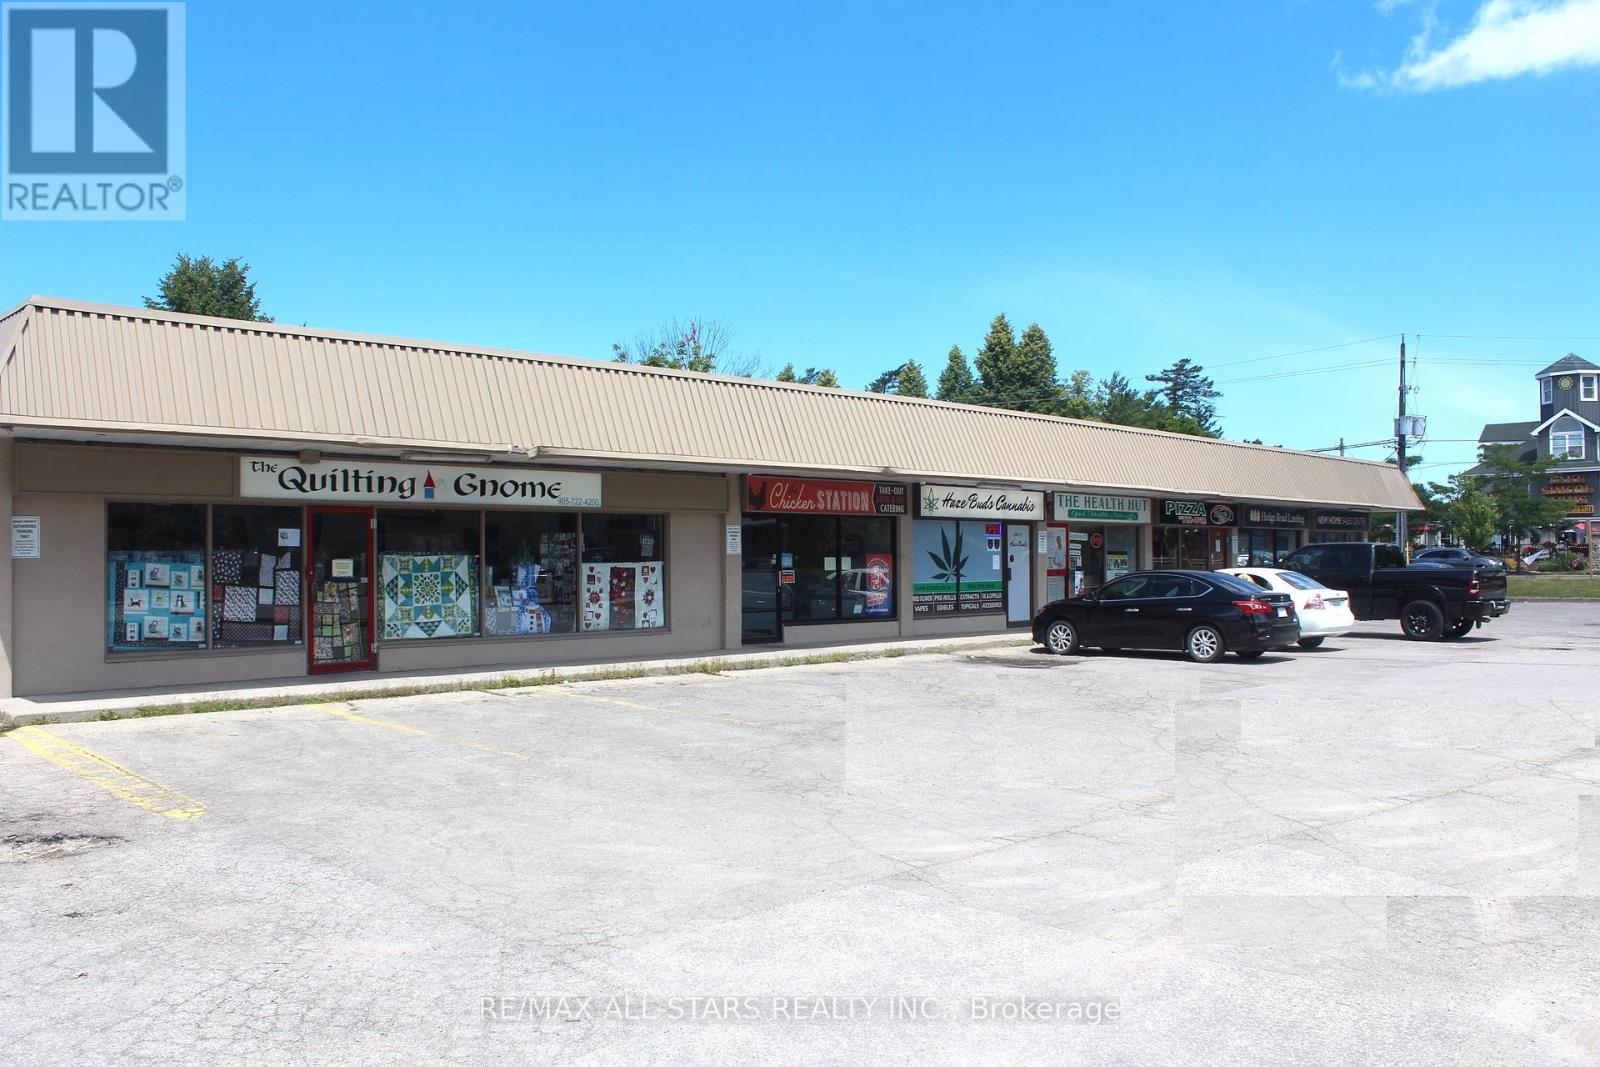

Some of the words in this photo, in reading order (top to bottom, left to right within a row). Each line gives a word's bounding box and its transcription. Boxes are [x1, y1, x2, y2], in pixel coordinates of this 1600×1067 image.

[278, 466, 416, 500] Quilting
[454, 472, 562, 499] Gnome
[879, 485, 904, 495] TAKE-OUT
[557, 497, 600, 507] 905-722-4200
[769, 482, 816, 509] Chicken
[816, 489, 869, 512] STATION
[942, 491, 968, 509] Haze
[968, 493, 994, 510] Buds
[995, 494, 1036, 512] Cannabis
[1058, 495, 1079, 508] THE
[1084, 496, 1124, 510] HEALTH
[1128, 498, 1148, 511] HUT
[880, 504, 905, 513] CATERING
[1165, 500, 1207, 516] PIZZA
[1317, 515, 1328, 524] NEW
[1328, 515, 1340, 525] HOME
